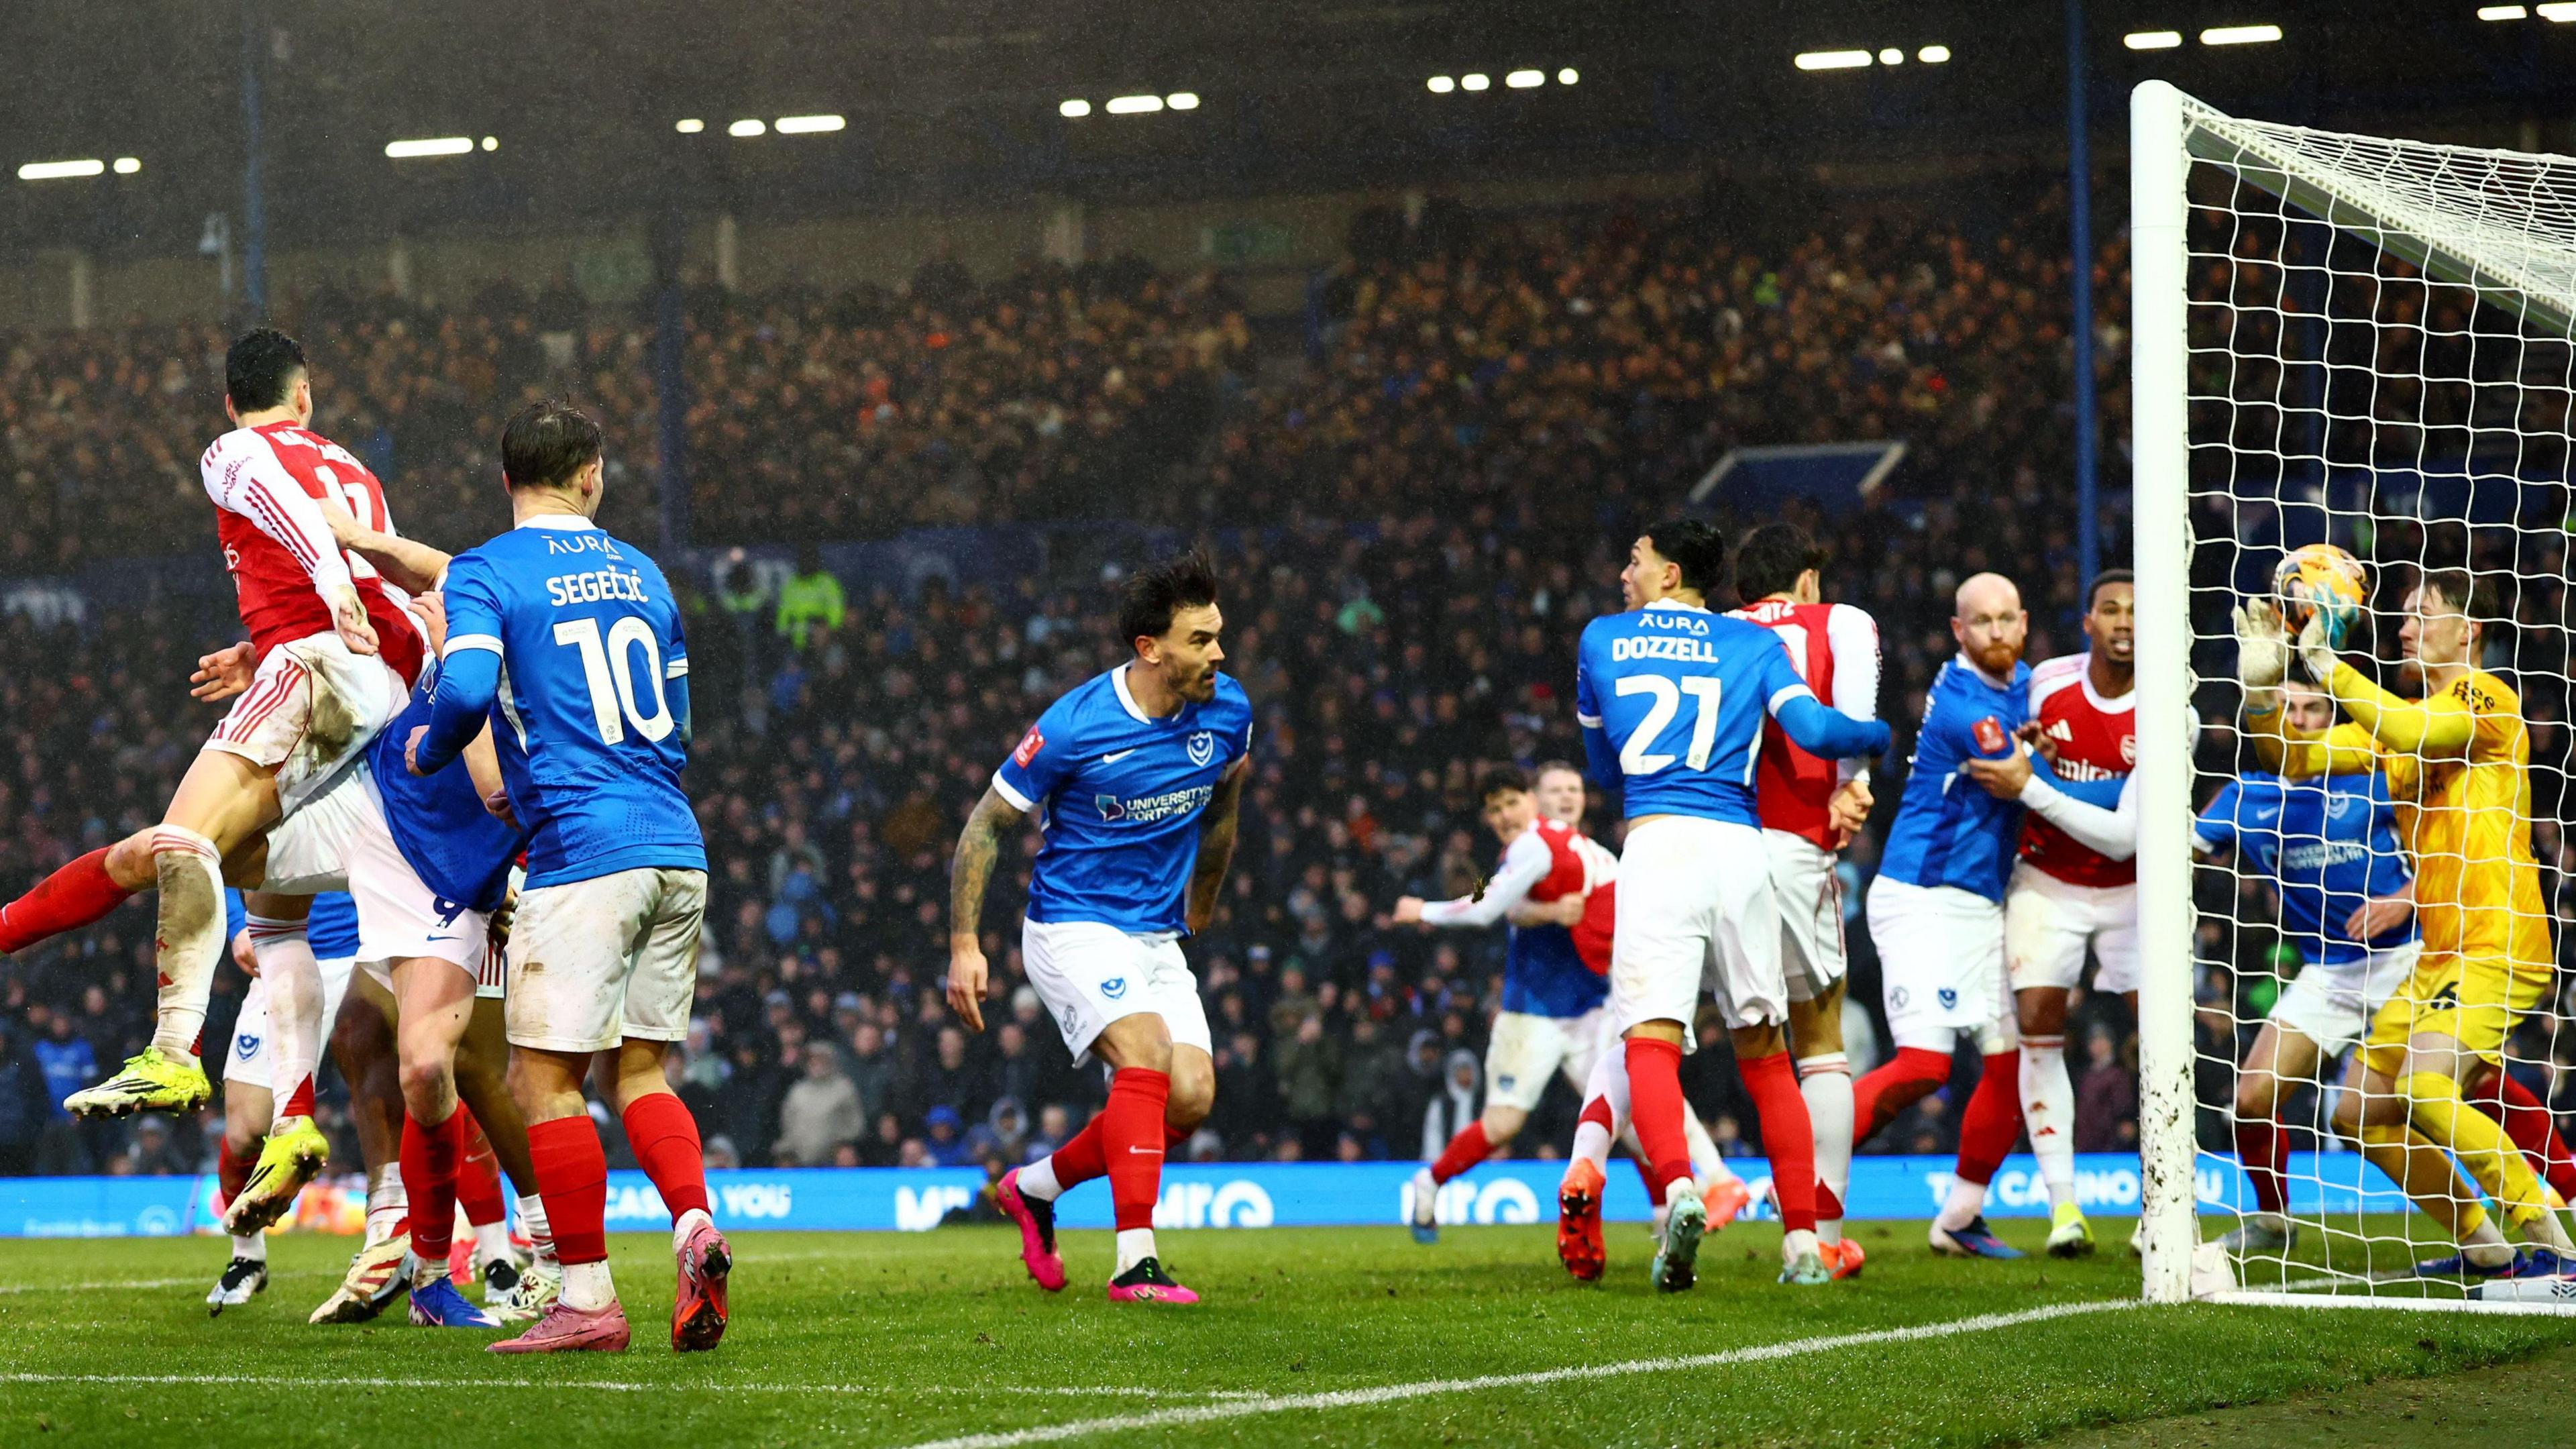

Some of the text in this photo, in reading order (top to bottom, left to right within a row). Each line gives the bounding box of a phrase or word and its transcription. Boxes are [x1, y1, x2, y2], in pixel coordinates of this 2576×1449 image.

[1612, 636, 1719, 663] DOZZELL
[553, 616, 675, 747] 10
[1615, 674, 1721, 775] 21
[433, 896, 467, 929] 9
[720, 1183, 792, 1218] YOU
